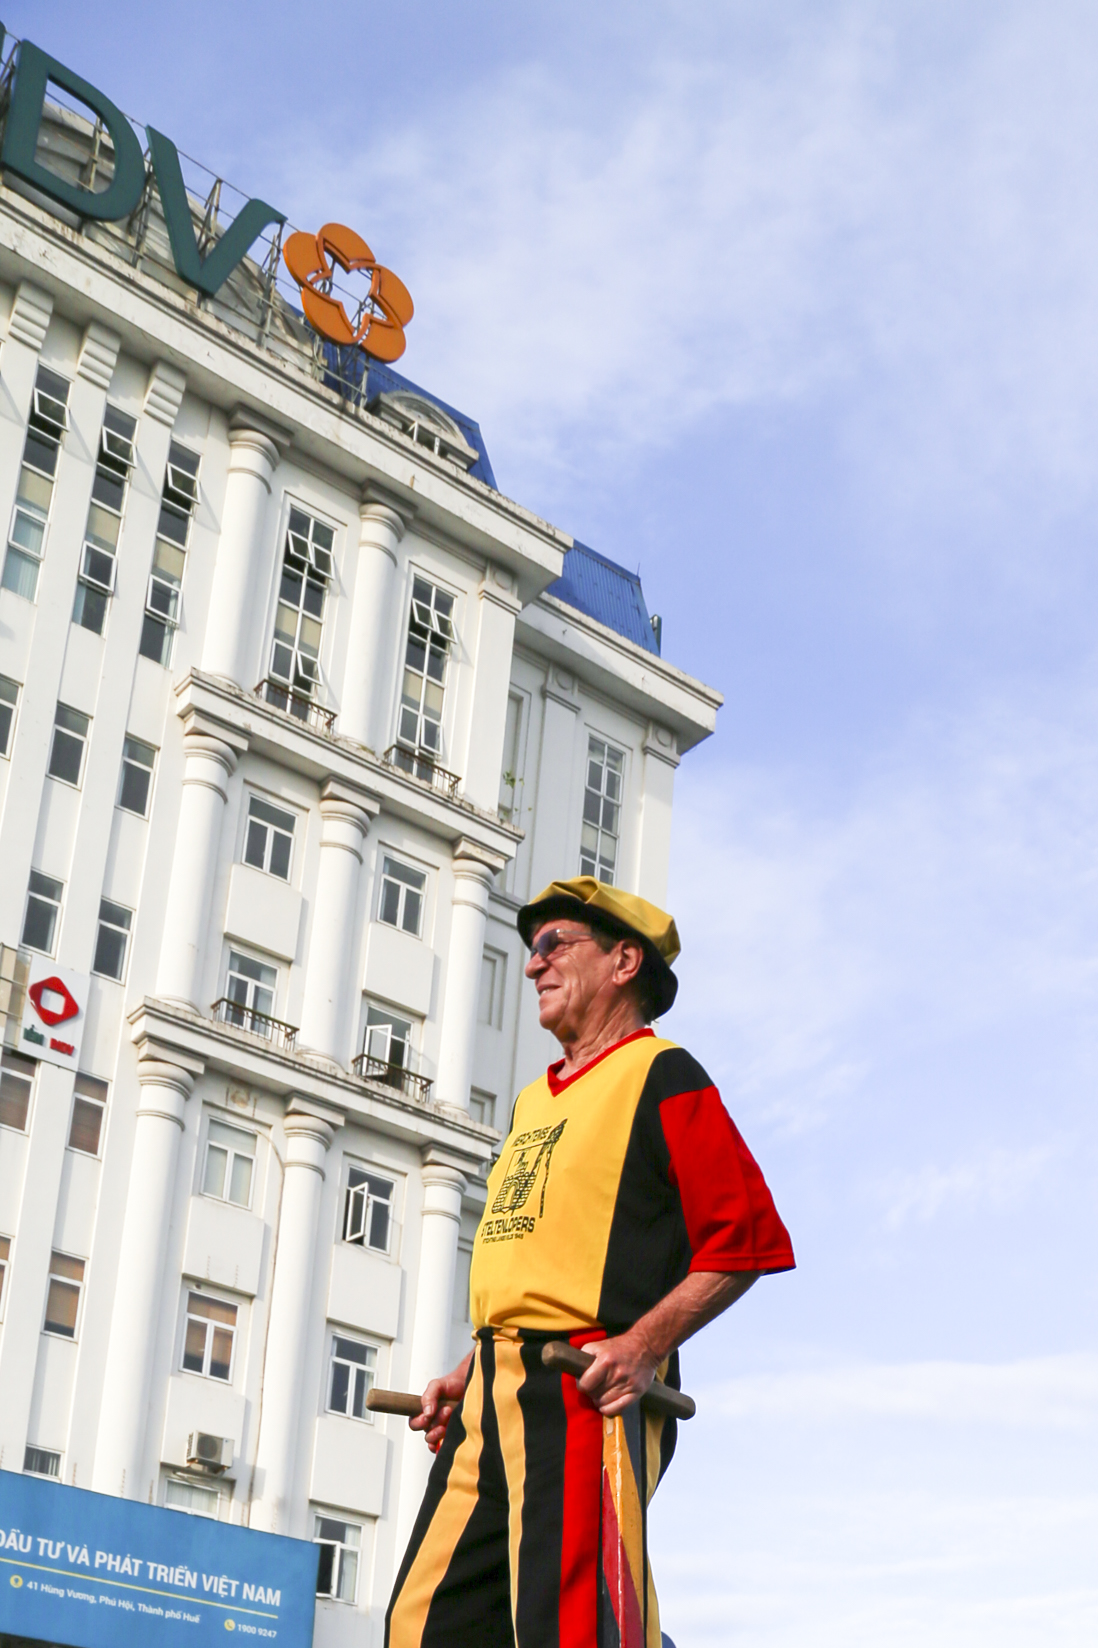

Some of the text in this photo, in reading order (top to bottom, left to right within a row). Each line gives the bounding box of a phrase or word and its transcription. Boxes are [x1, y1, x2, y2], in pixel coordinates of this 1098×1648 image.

[37, 1537, 65, 1559] TƯ
[67, 1544, 90, 1567] VÀ
[94, 1550, 143, 1577] PHÁT
[146, 1561, 198, 1589] TRIỂN
[201, 1573, 240, 1598] VIỆT
[242, 1582, 281, 1607] NAM
[26, 1581, 38, 1591] 41
[137, 1603, 164, 1617] Thành
[165, 1609, 182, 1621] phố
[182, 1612, 200, 1624] Huế
[237, 1624, 277, 1638] 1900 9247
